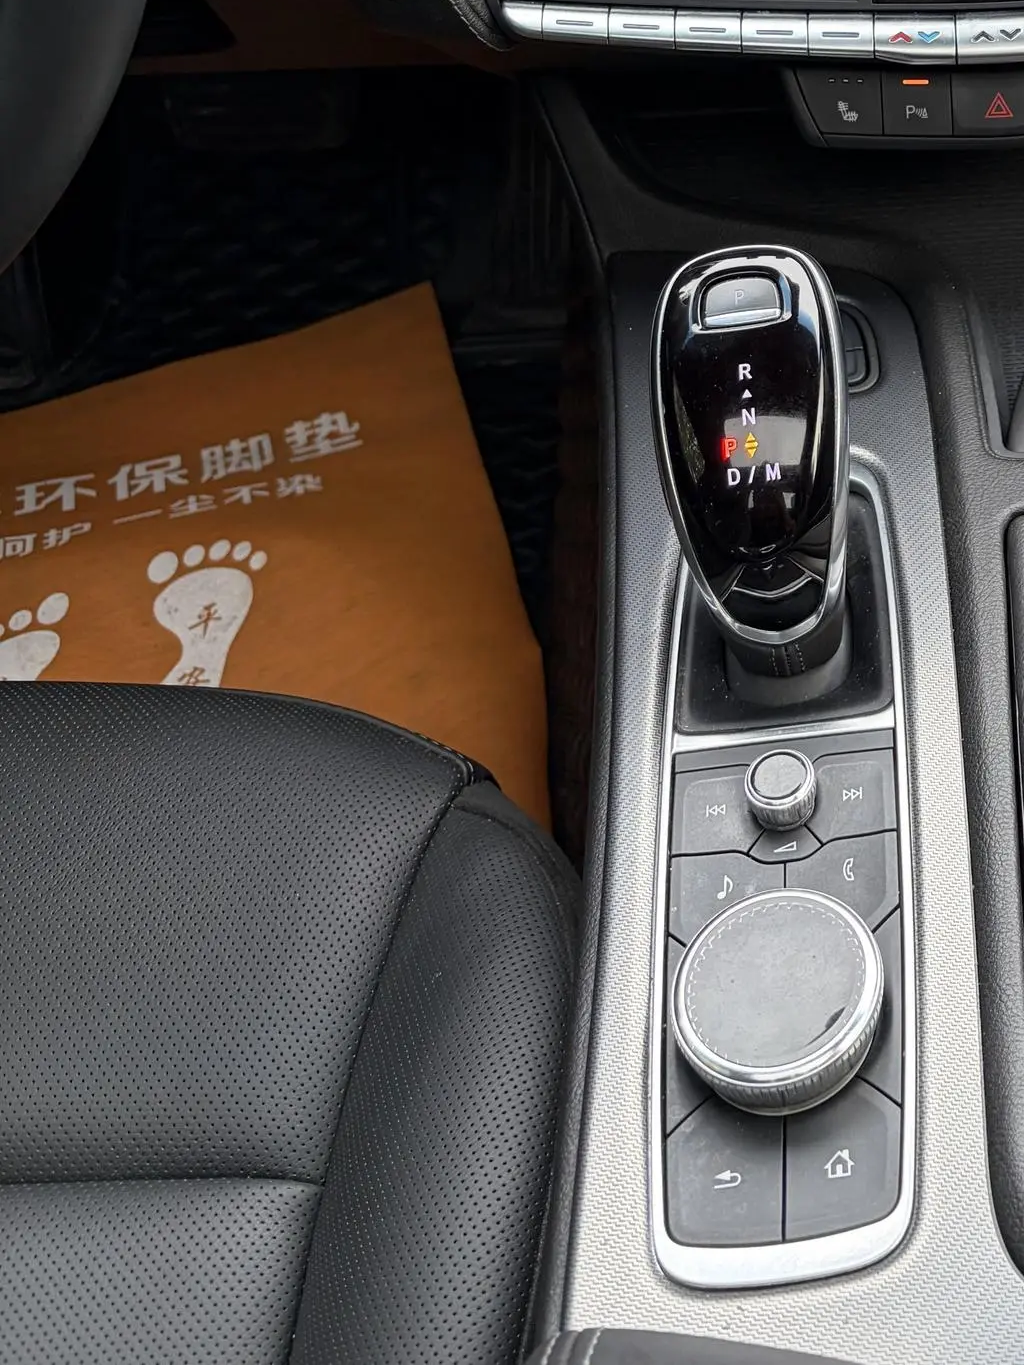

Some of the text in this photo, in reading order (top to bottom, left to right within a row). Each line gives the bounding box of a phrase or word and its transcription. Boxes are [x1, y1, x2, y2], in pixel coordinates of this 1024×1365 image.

[733, 289, 746, 305] P
[738, 363, 753, 381] R
[741, 407, 757, 426] N
[724, 438, 737, 458] P
[0, 411, 363, 516] 环保脚垫
[112, 473, 323, 524] 一尘不染
